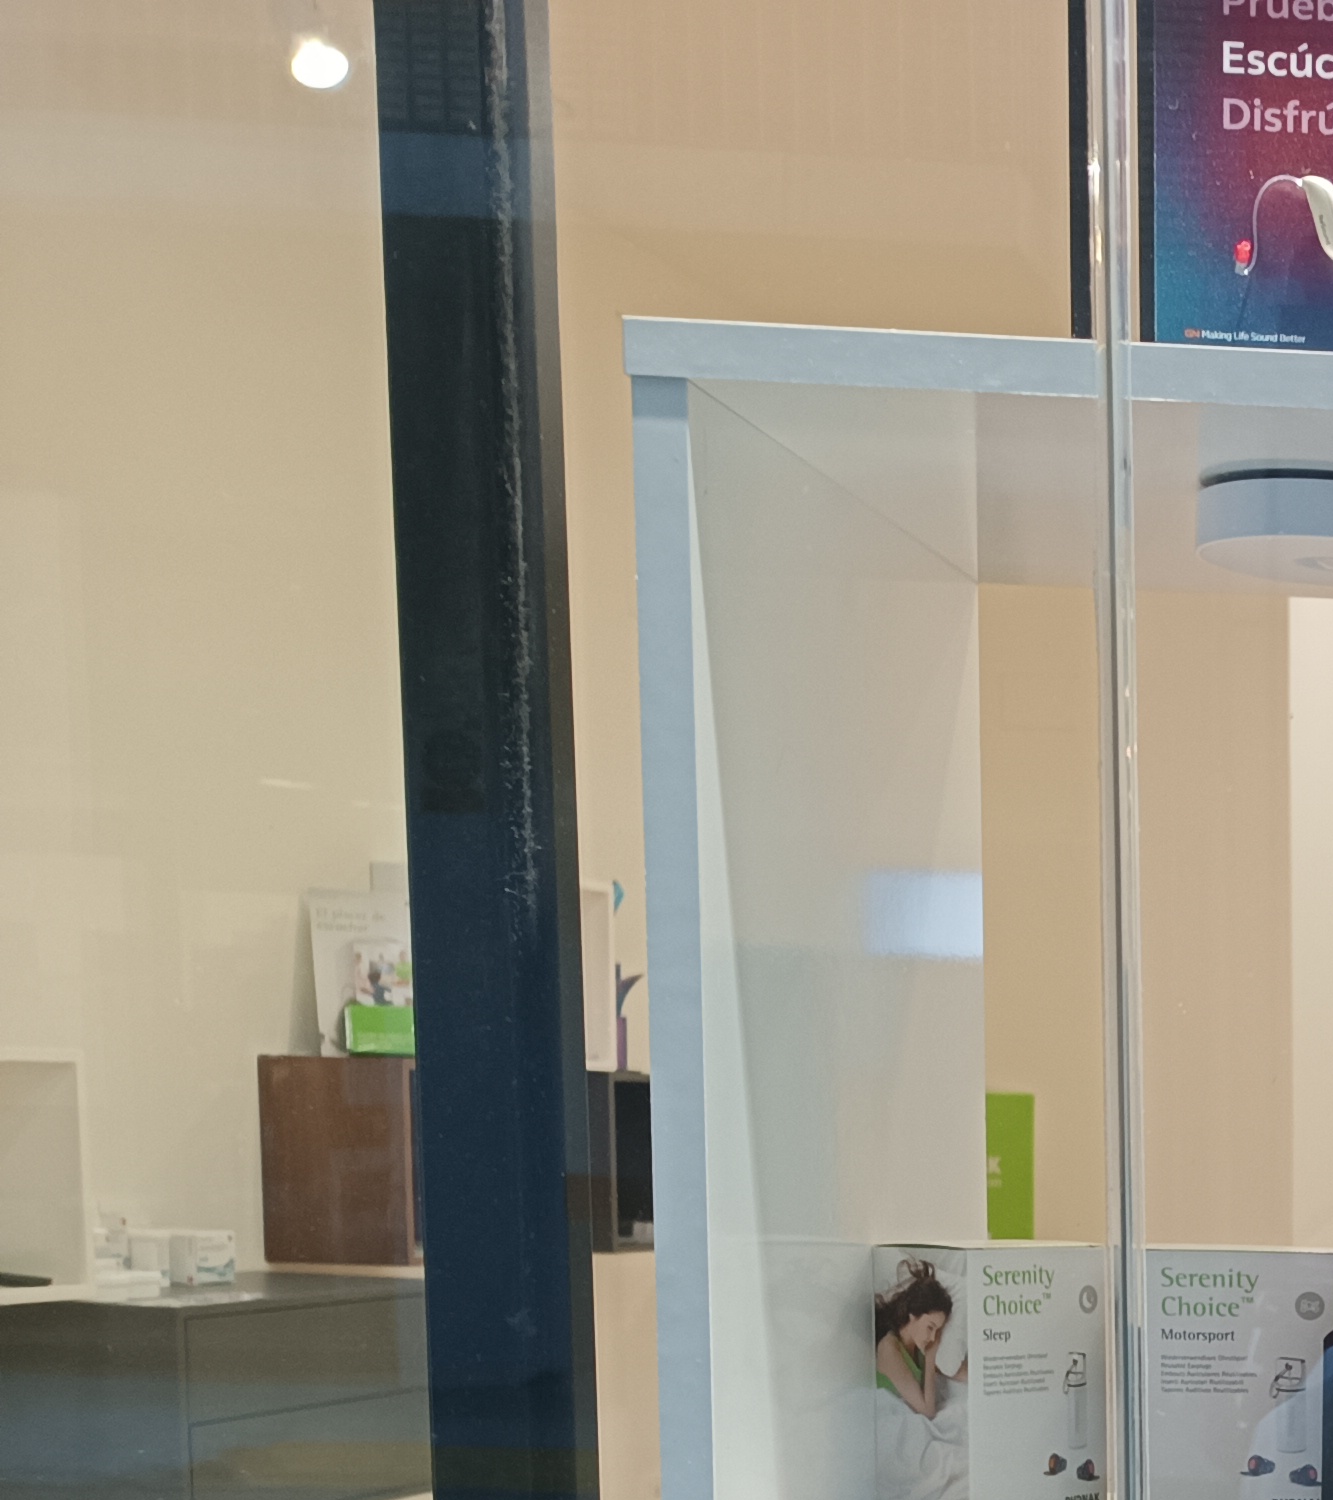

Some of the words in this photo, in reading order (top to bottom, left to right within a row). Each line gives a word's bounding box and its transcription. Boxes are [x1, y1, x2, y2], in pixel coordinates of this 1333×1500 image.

[1201, 330, 1232, 342] Making
[1233, 331, 1249, 341] Life
[1250, 332, 1278, 342] Sound
[983, 1264, 1055, 1289] Serenity
[1160, 1266, 1259, 1293] Serenity
[982, 1328, 1011, 1343] Sleep
[1161, 1328, 1235, 1343] Motorsport
